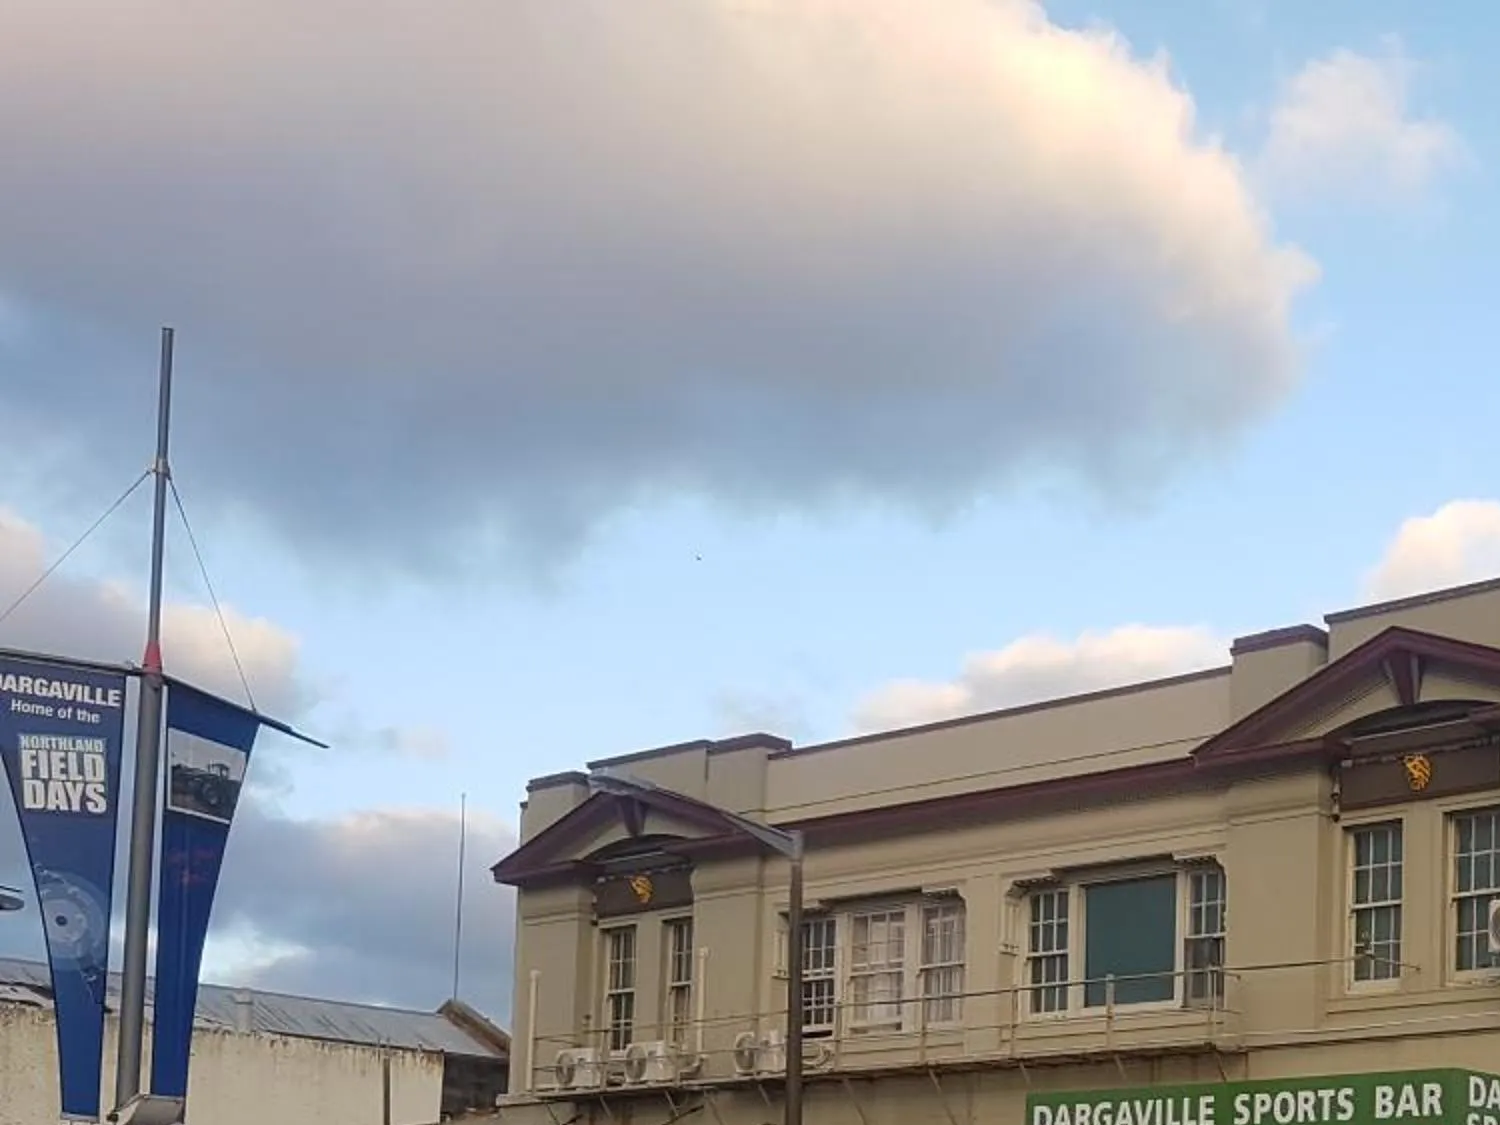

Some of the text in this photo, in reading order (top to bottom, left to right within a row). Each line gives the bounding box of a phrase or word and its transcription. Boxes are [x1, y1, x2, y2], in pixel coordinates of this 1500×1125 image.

[0, 675, 122, 707] ARGAVILLE
[11, 700, 101, 724] Home of the
[20, 736, 104, 752] NORTHLAND
[22, 750, 105, 782] FIELD
[23, 779, 107, 814] DAYS
[1375, 1082, 1444, 1119] BAR
